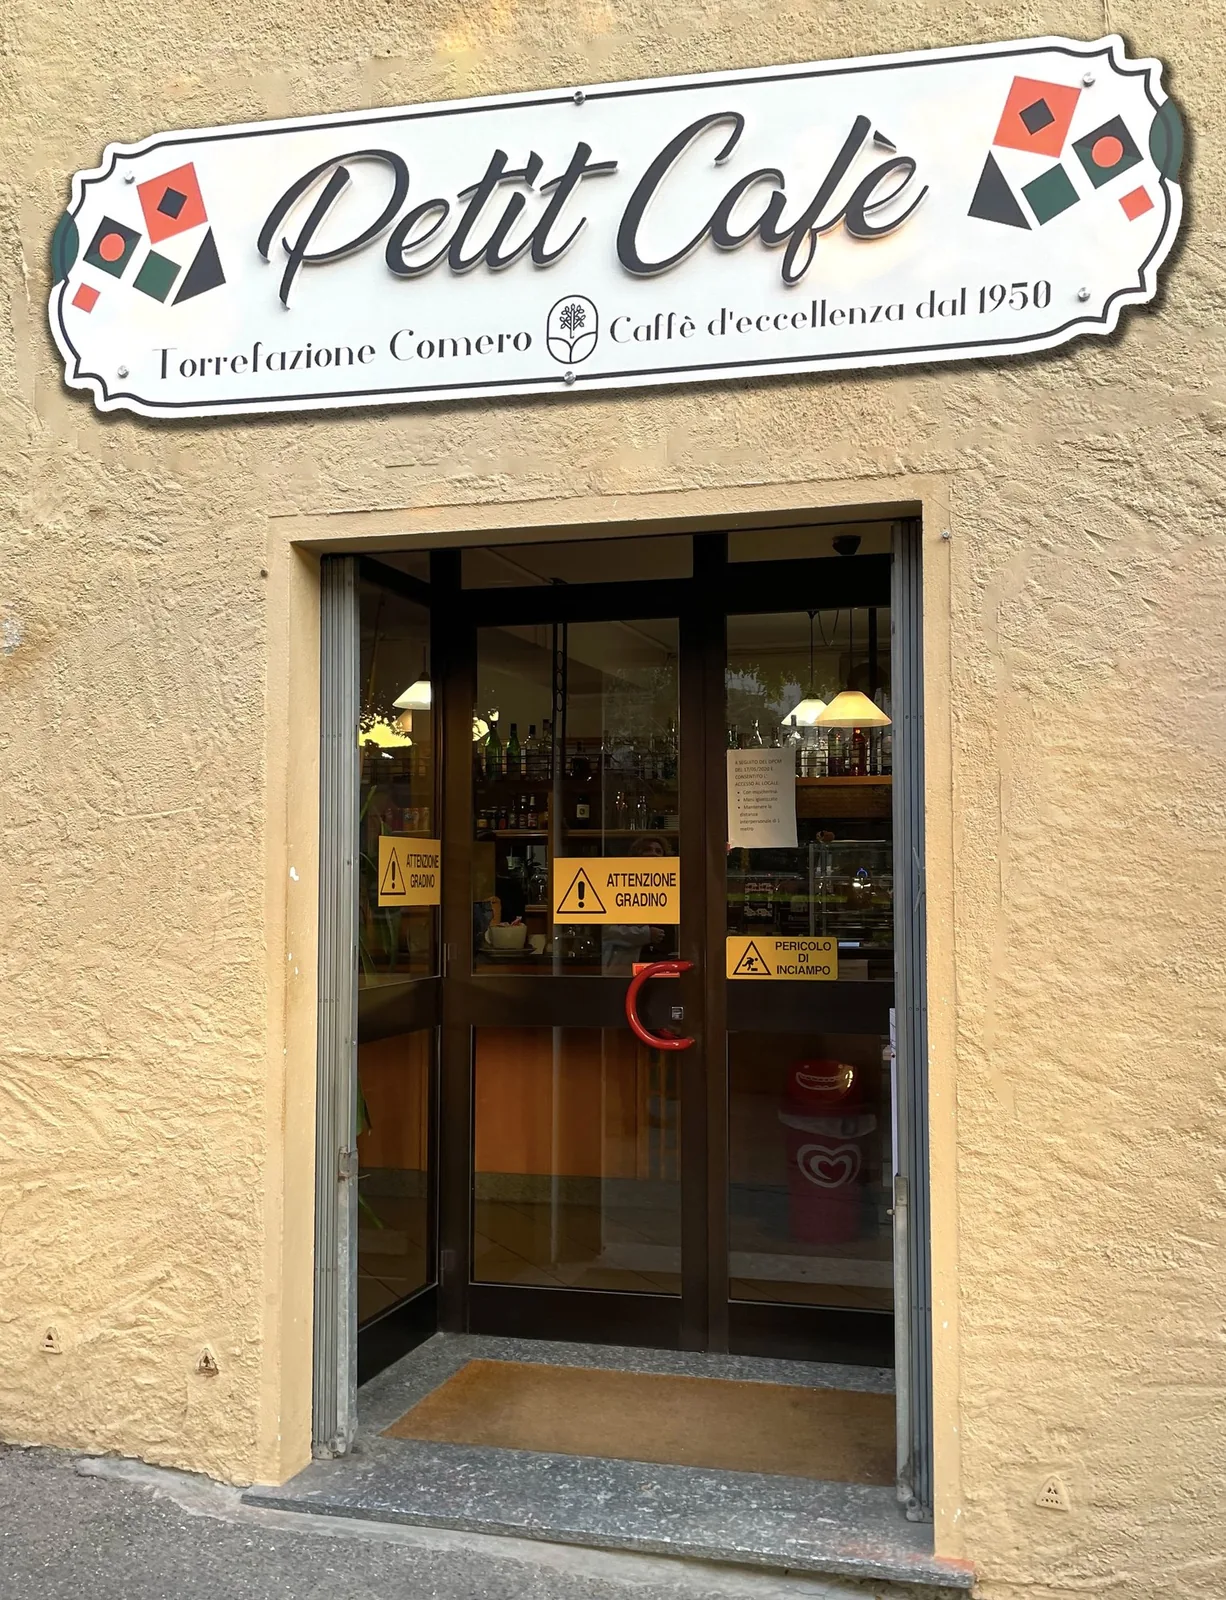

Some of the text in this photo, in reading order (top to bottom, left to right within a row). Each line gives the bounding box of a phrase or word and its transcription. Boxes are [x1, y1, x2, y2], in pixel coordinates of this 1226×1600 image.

[257, 111, 930, 309] Petit Cafè
[152, 280, 1052, 380] Torrefazione Comero Caffè d'eccellenza dal 1950
[406, 853, 439, 868] ATTENZIONE
[410, 873, 436, 888] GRADINO
[606, 872, 676, 888] ATTENZIONE
[615, 892, 668, 907] GRADINO
[775, 941, 832, 951] PERICOLO
[798, 953, 809, 963] DI
[776, 965, 831, 975] INCIAMPO
